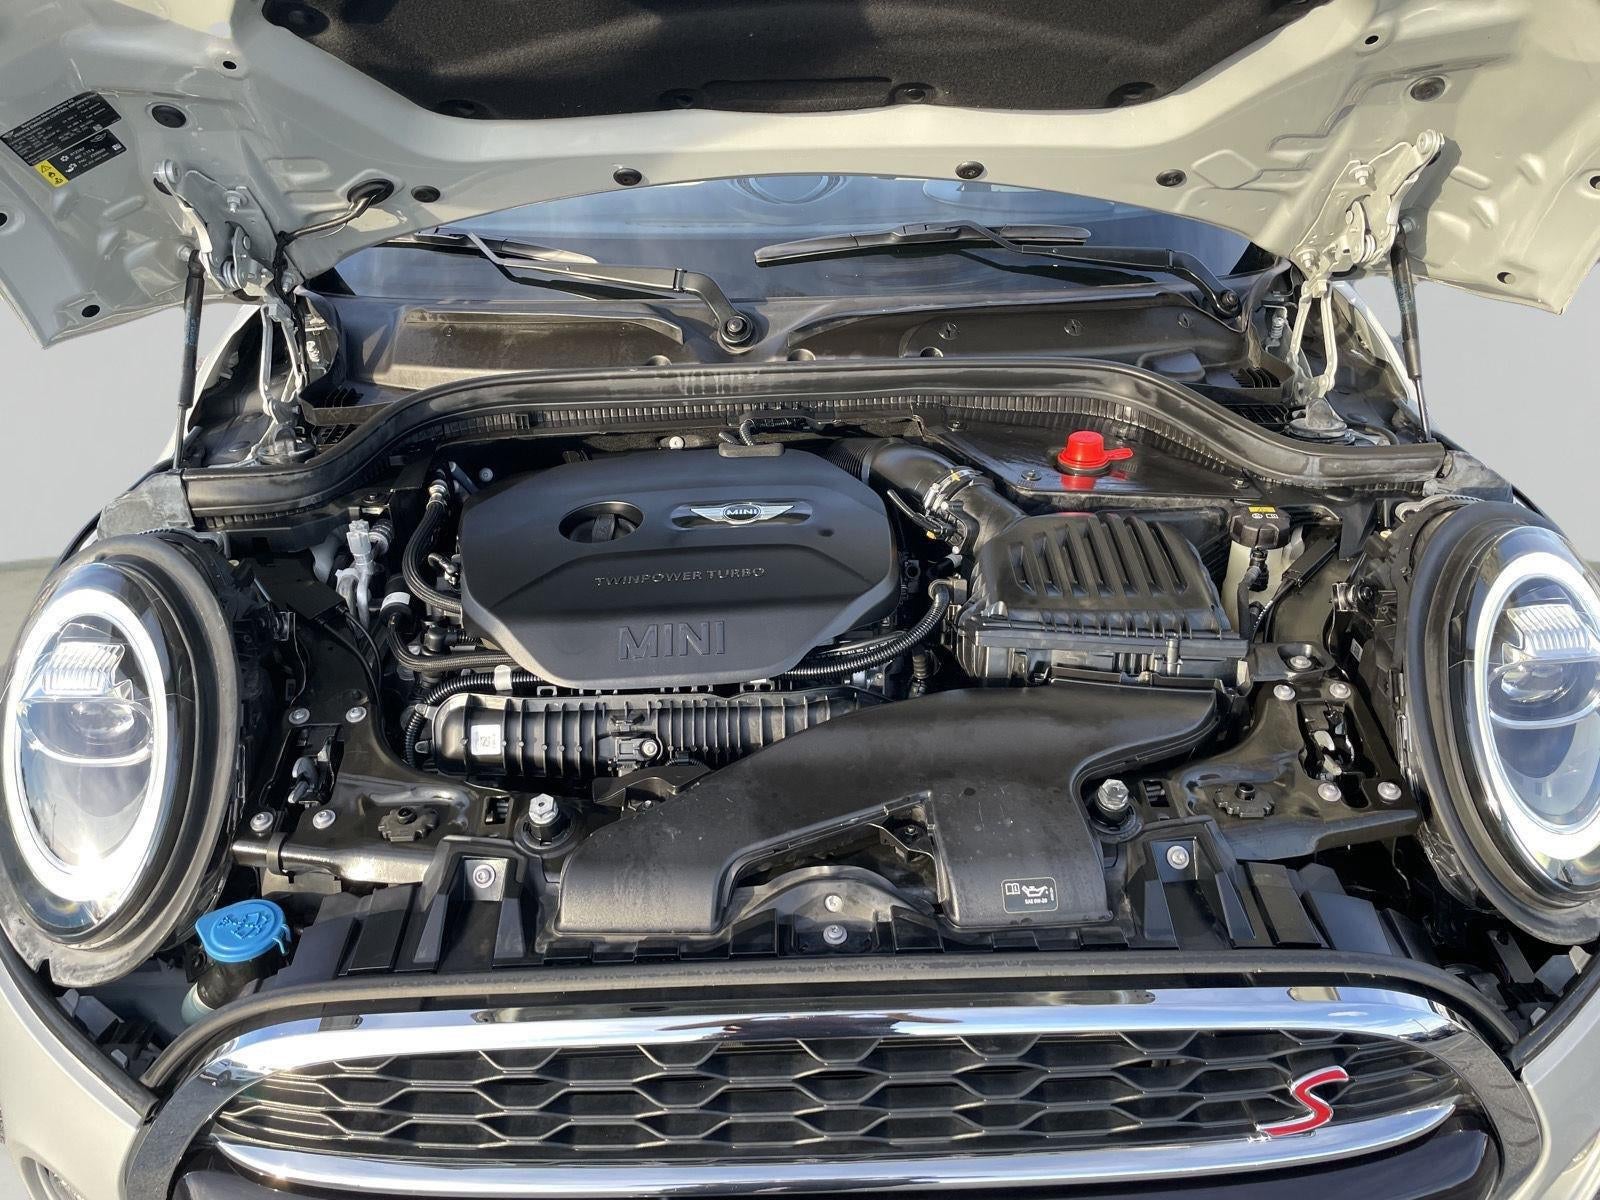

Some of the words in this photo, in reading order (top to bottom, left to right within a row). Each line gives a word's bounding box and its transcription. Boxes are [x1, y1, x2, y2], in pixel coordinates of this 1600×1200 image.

[594, 571, 702, 586] TWINPOWER
[706, 567, 765, 579] TURBO
[617, 620, 725, 661] MINI
